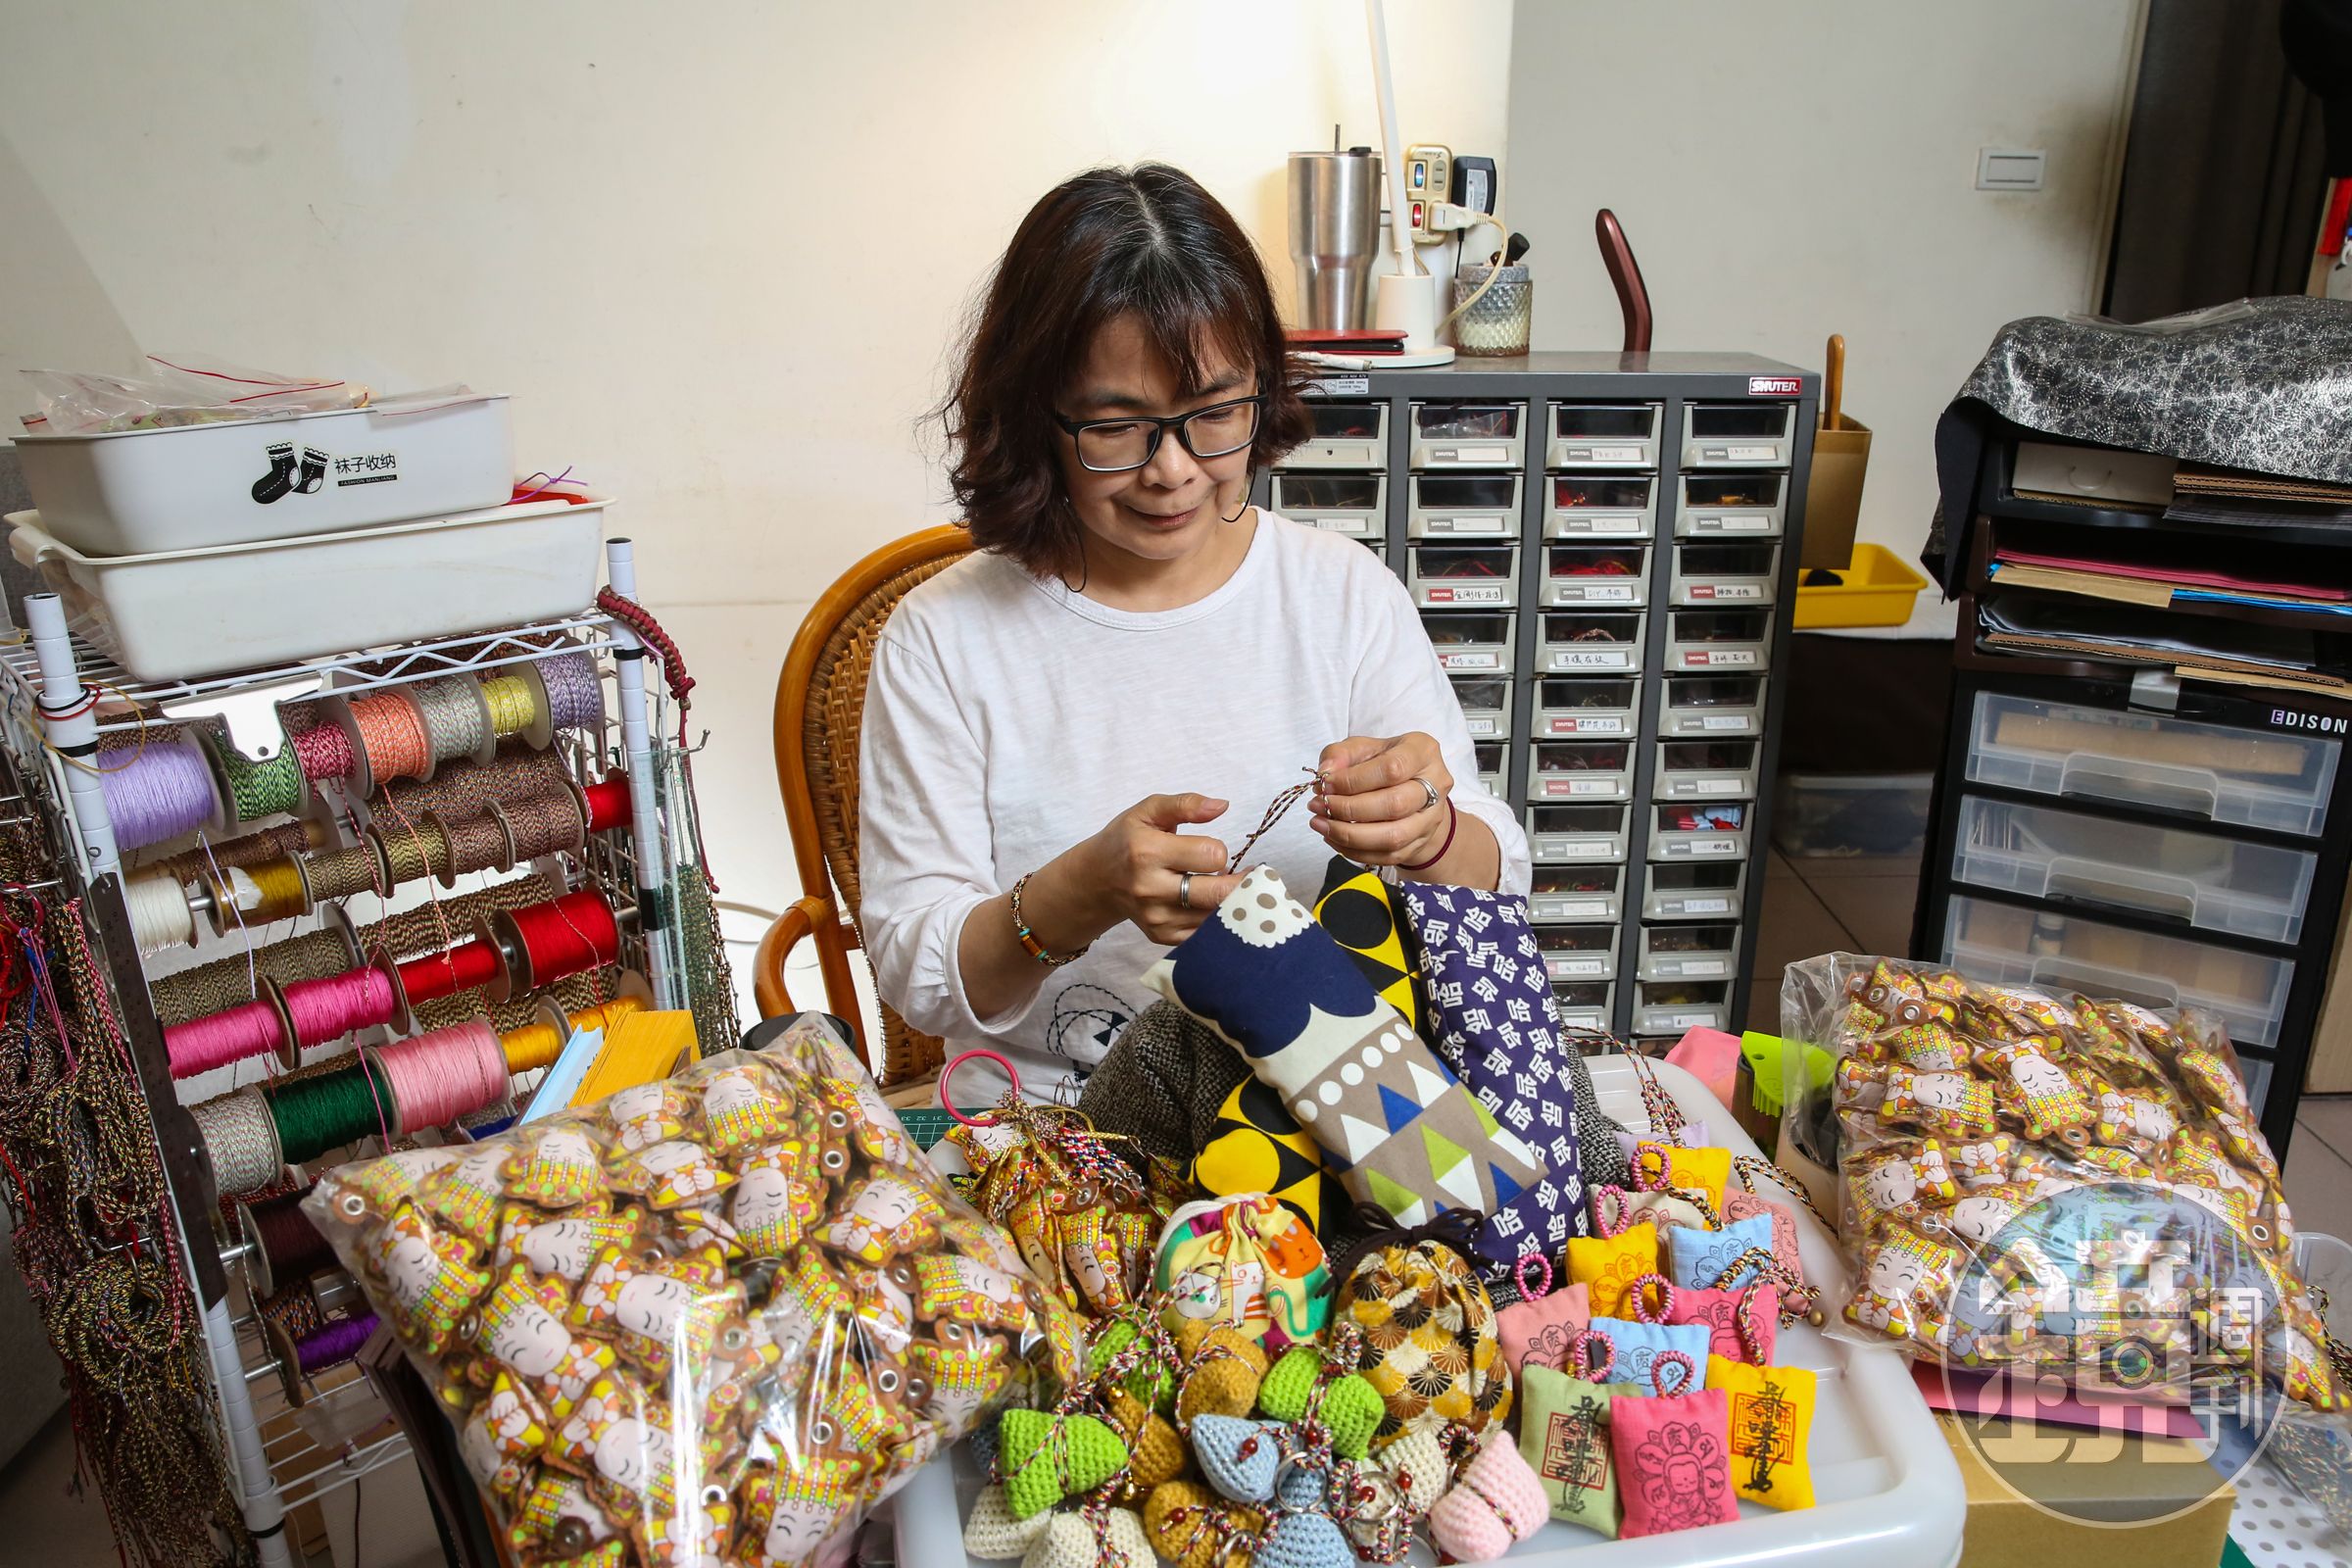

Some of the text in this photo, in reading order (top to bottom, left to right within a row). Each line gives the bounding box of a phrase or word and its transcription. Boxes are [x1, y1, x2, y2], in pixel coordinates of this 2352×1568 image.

[1750, 379, 1798, 392] SHUTER
[334, 453, 396, 474] 袜子收纳
[2271, 710, 2348, 733] EDISON
[1424, 919, 1449, 947] 哈
[1463, 906, 1493, 933] 哈
[1493, 954, 1519, 983] 哈
[1524, 964, 1545, 993] 哈
[1439, 982, 1463, 1008] 哈
[1471, 976, 1499, 1003] 哈
[1462, 1008, 1493, 1034] 哈
[1506, 998, 1532, 1022] 哈
[1496, 1021, 1522, 1050] 哈
[1528, 1027, 1554, 1054] 哈
[1483, 1047, 1512, 1077] 哈
[1529, 1053, 1554, 1084] 哈
[1515, 1072, 1538, 1100] 哈
[1504, 1099, 1534, 1131] 哈
[1541, 1100, 1562, 1128] 哈
[1550, 1135, 1571, 1167] 哈
[1535, 1179, 1559, 1211] 哈
[1563, 1174, 1582, 1204] 哈
[1492, 1206, 1524, 1238] 哈
[1546, 1213, 1566, 1243] 哈
